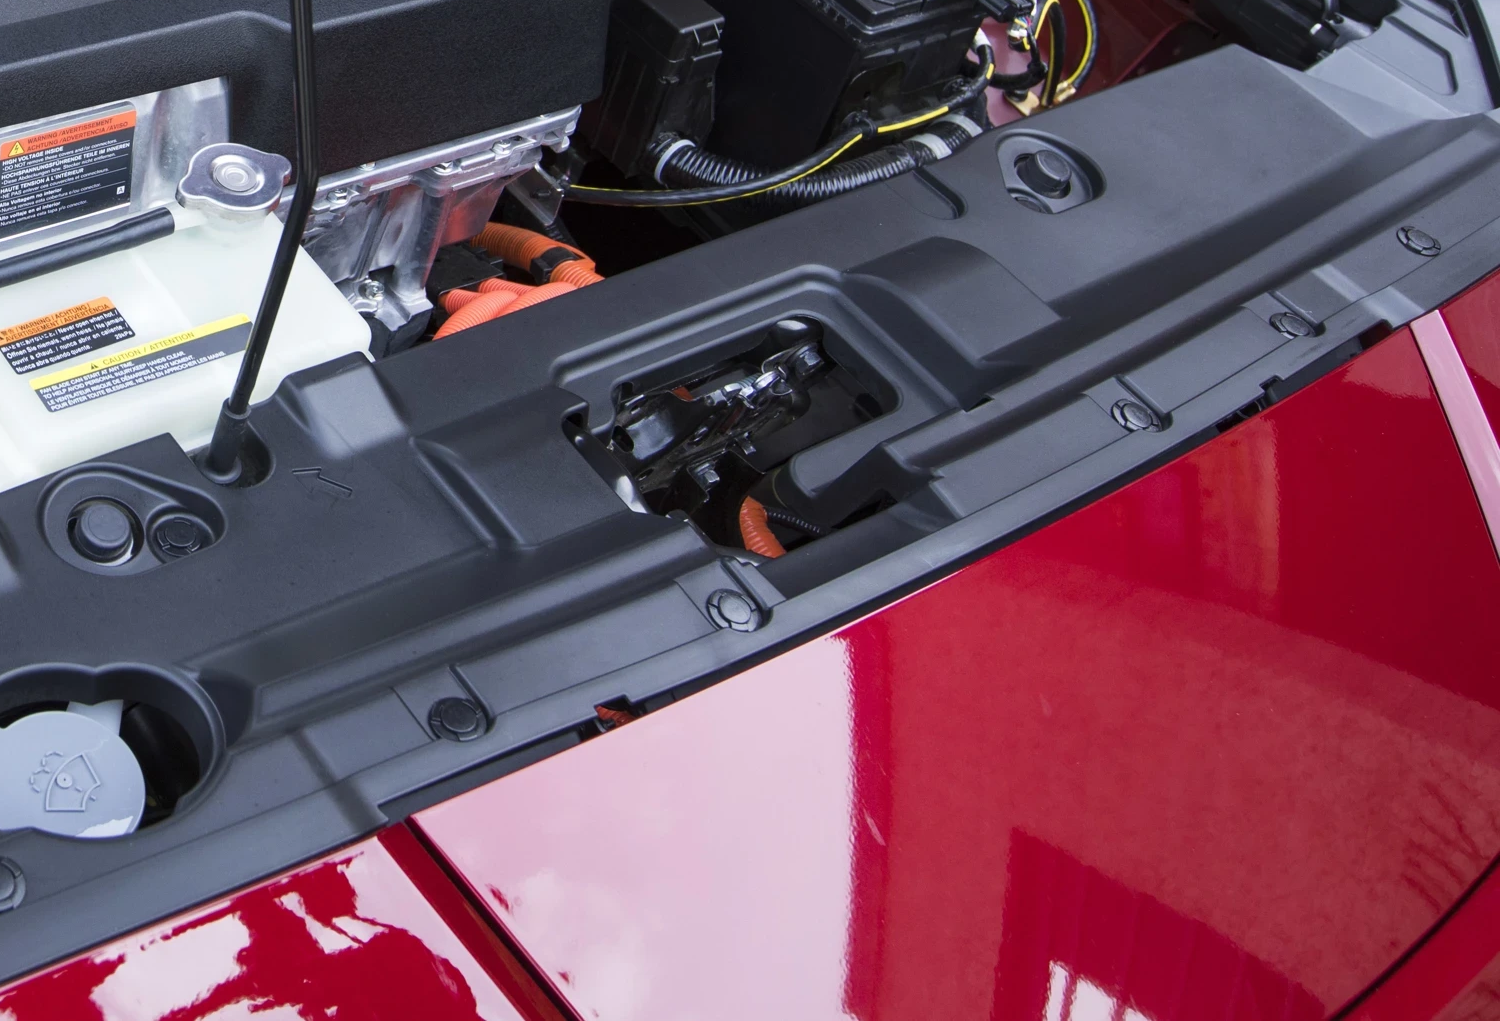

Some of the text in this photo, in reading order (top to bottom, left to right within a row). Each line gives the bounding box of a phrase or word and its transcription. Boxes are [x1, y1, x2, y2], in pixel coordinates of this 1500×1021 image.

[26, 139, 58, 152] ACHTUNG
[27, 131, 57, 144] WARNING
[2, 146, 64, 166] HIGH VOLTAGE INSIDE
[83, 150, 98, 159] TEILE
[106, 142, 130, 153] INNEREN
[14, 161, 26, 169] NOT
[27, 157, 44, 166] remove
[18, 169, 50, 182] Abdeckungen
[63, 161, 81, 170] Stecker
[81, 157, 93, 165] nicht
[0, 184, 19, 194] HAUTE
[20, 178, 45, 189] TENSION
[11, 189, 22, 197] PAS
[22, 186, 39, 194] enlever
[49, 176, 75, 187] couvercles
[19, 316, 51, 331] WARNING
[55, 304, 87, 319] ACHTUNG
[58, 323, 75, 334] Never
[75, 320, 90, 329] open
[89, 314, 105, 323] when
[5, 319, 59, 342] AVERTISSEMENT
[26, 345, 37, 353] Sie
[61, 332, 77, 341] wenn
[104, 316, 124, 327] jamais
[11, 356, 29, 366] ouvrir
[59, 341, 77, 350] nunca
[77, 335, 91, 344] abrir
[102, 348, 142, 366] CAUTION
[149, 331, 195, 351] ATTENTION
[15, 362, 36, 373] Nunca
[35, 358, 49, 367] abra
[49, 352, 71, 363] quando
[39, 387, 52, 395] FAN
[51, 380, 71, 390] BLADE
[70, 376, 84, 384] CAN
[83, 371, 101, 381] START
[108, 365, 120, 373] ANY
[46, 398, 55, 406] LE
[55, 387, 92, 403] VENTILATEUR
[90, 381, 113, 393] RISQUE
[155, 362, 170, 371] TOUT
[50, 401, 69, 411] POUR
[87, 389, 106, 399] TOUTE
[143, 373, 156, 382] PAS
[155, 370, 165, 379] EN
[164, 359, 197, 375] APPROCHER
[196, 356, 208, 365] LES
[51, 388, 67, 397] HELP
[67, 383, 85, 392] AVOID
[84, 374, 114, 387] PERSONAL
[146, 356, 167, 367] HANDS
